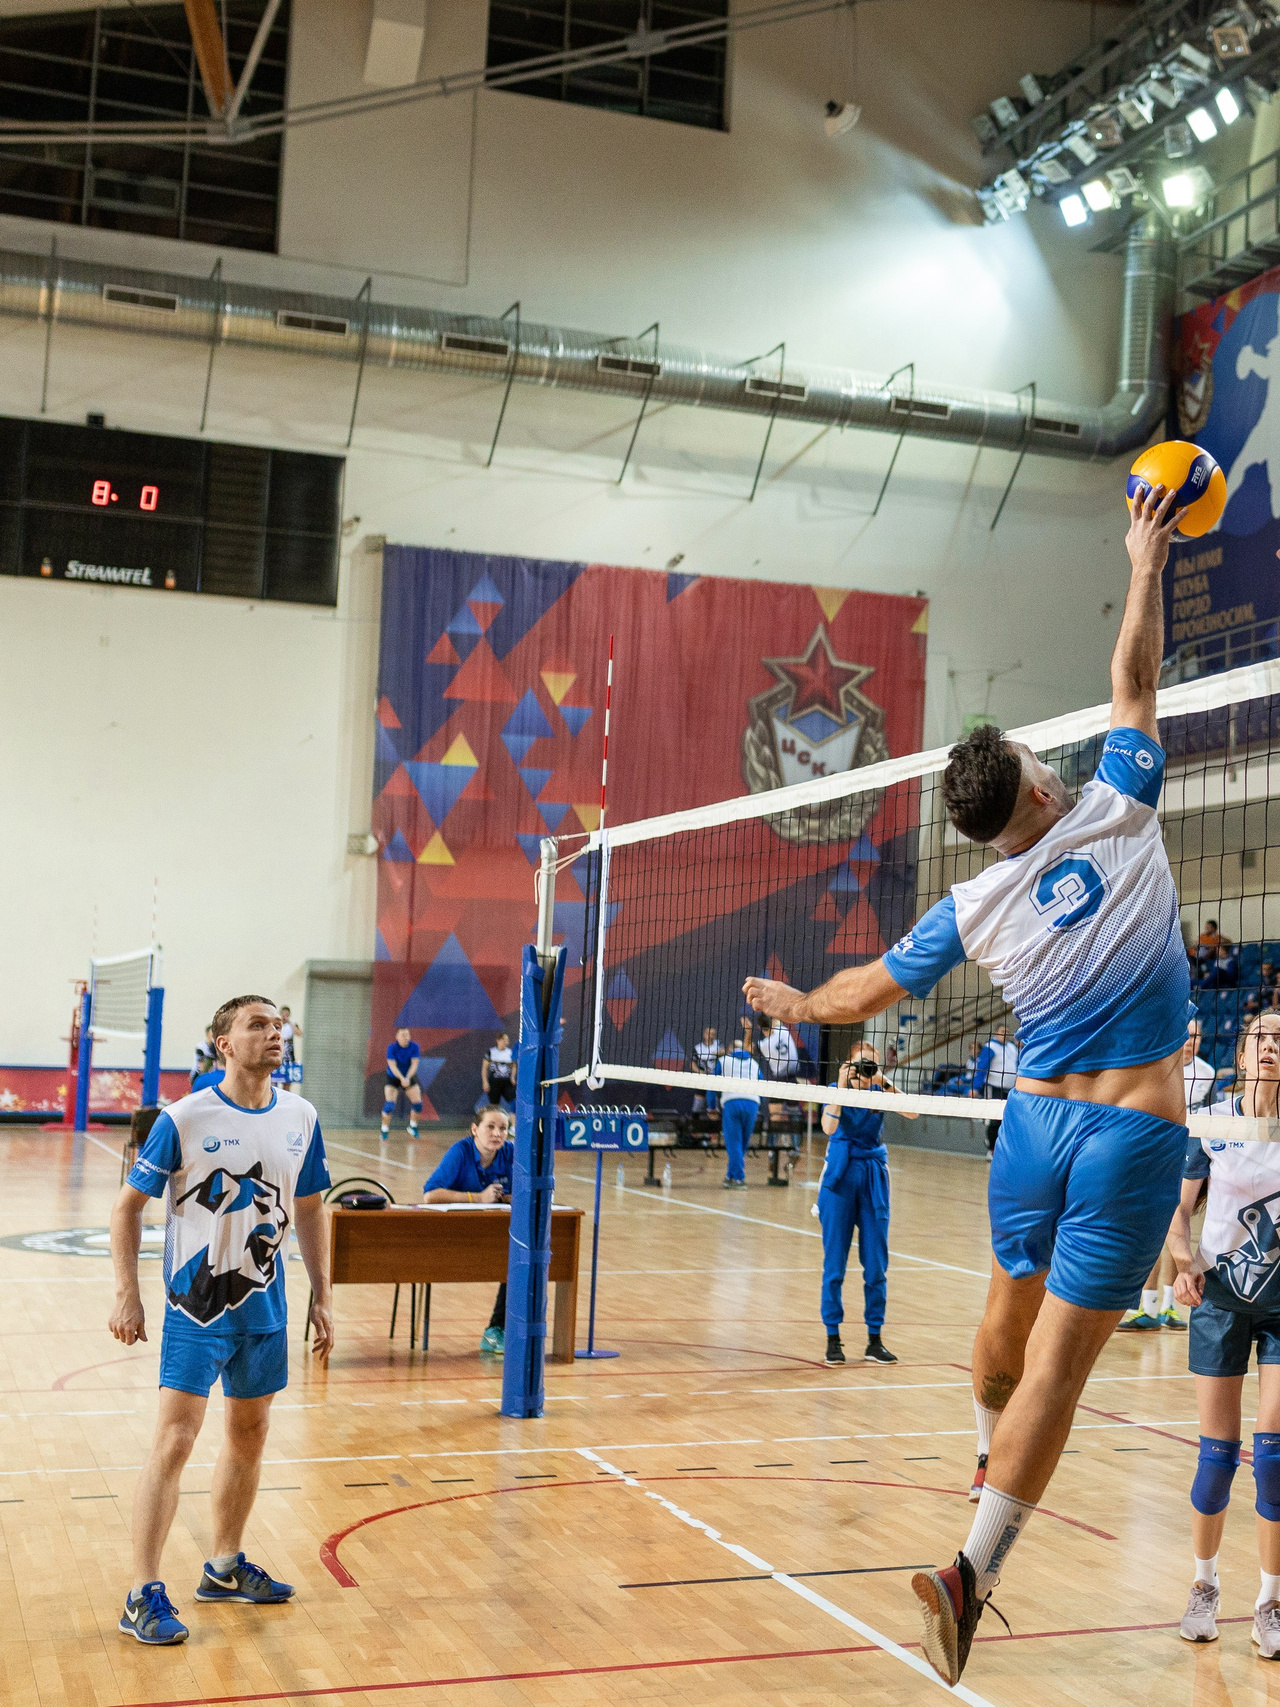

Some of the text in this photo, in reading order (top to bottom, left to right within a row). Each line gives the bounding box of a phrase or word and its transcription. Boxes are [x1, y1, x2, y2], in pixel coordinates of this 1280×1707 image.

[782, 737, 838, 776] ЦСК
[569, 1121, 588, 1146] 2
[627, 1123, 644, 1147] 0
[985, 1525, 1019, 1573] ORIGINAL
